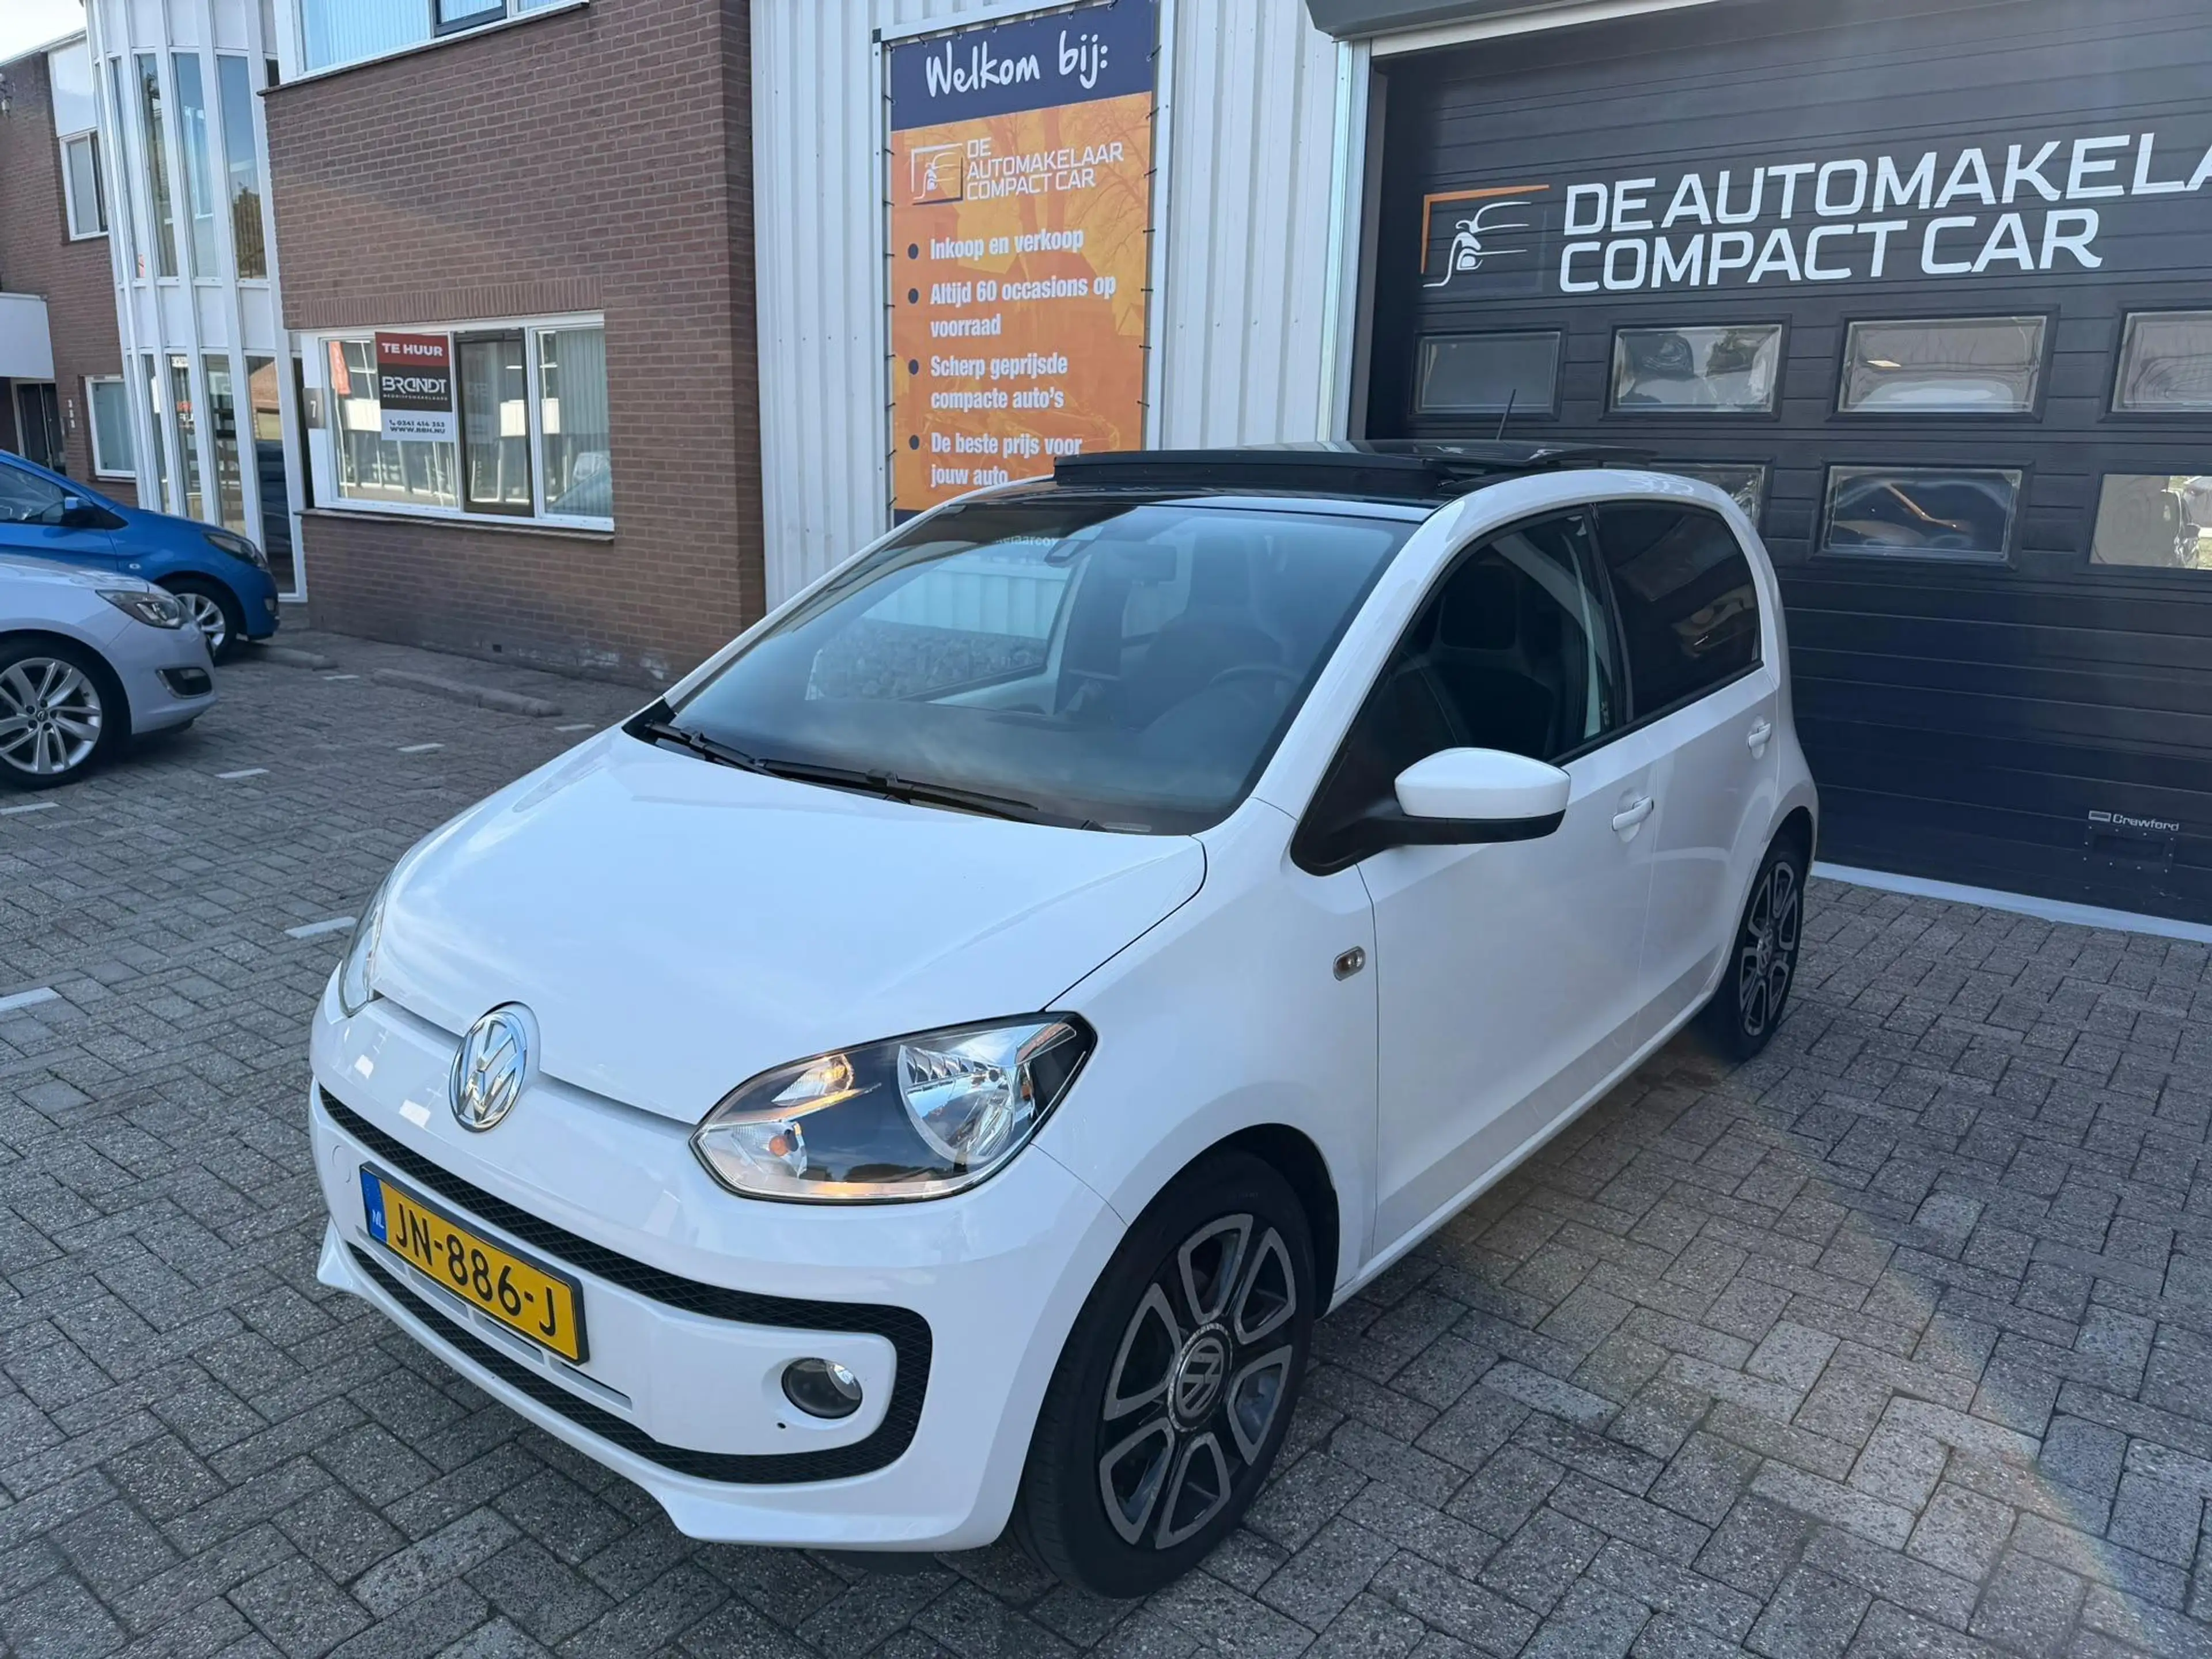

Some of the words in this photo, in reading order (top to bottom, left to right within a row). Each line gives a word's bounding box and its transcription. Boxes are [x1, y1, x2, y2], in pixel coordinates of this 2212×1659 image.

[926, 40, 1040, 97] Welkom
[1059, 30, 1108, 89] bij:
[967, 138, 992, 158] DE
[967, 142, 1124, 180] AUTOMAKELAAR
[967, 172, 1053, 201] COMPACT
[1055, 169, 1096, 190] CAR
[1564, 177, 1656, 236] DE
[930, 237, 984, 260] Inkoop
[988, 238, 1010, 255] en
[1014, 228, 1084, 254] verkoop
[1558, 220, 1908, 293] COMPACT
[1920, 208, 2104, 275] CAR
[930, 281, 972, 308] Altijd
[976, 280, 998, 302] 60
[1002, 275, 1088, 301] occasions
[1093, 276, 1116, 299] op
[930, 313, 1001, 338] voorraad
[381, 343, 400, 354] TE
[403, 344, 443, 357] HUUR
[930, 354, 986, 380] Scherp
[990, 352, 1068, 379] geprijsde
[382, 376, 447, 394] BRANDT
[310, 400, 317, 418] 7
[930, 388, 1007, 413] compacte
[1012, 387, 1065, 408] auto's
[930, 432, 951, 454] De
[955, 433, 998, 454] beste
[1003, 434, 1040, 459] prijs
[1044, 437, 1082, 456] voor
[930, 464, 968, 488] jouw
[973, 466, 1009, 486] auto
[2112, 813, 2180, 831] Crawford
[372, 1209, 385, 1229] NL
[396, 1202, 556, 1336] JN-886-J
